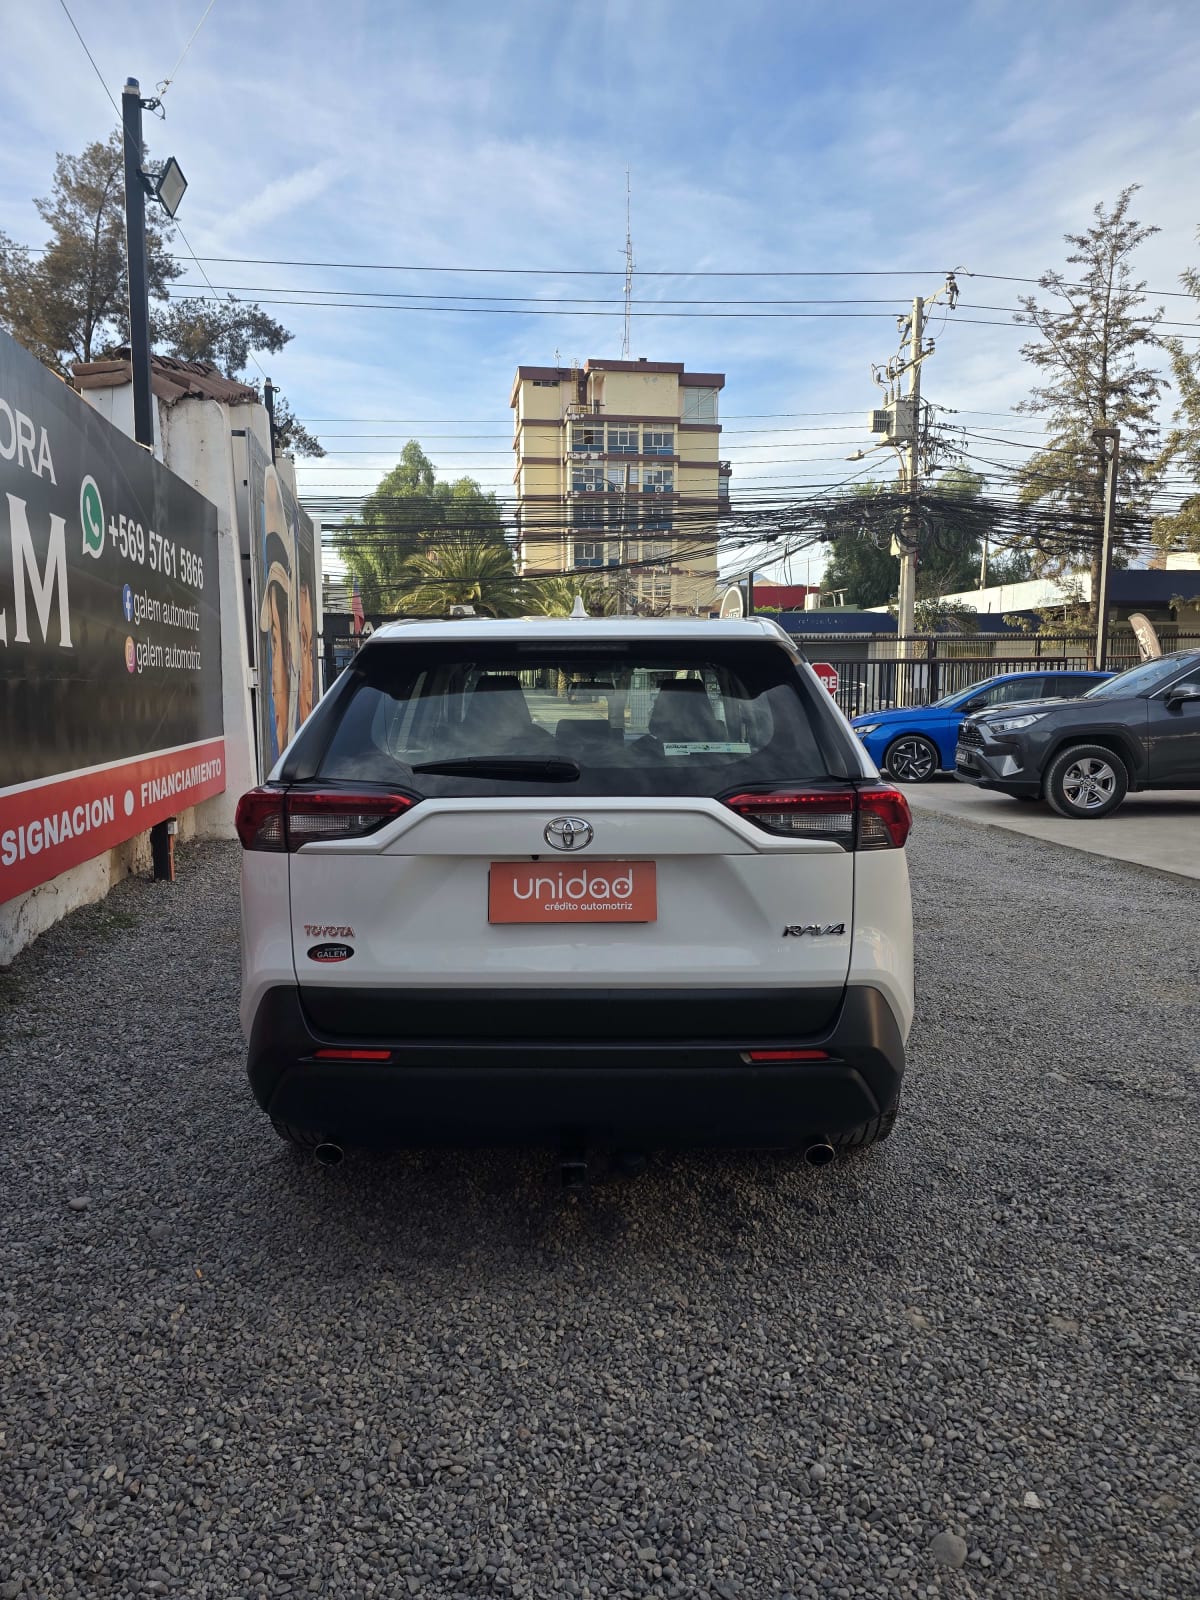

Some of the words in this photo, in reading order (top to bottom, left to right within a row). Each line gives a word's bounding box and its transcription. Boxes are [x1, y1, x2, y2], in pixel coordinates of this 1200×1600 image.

[109, 514, 145, 565] +569
[149, 530, 177, 579] 5761
[180, 547, 204, 590] 5866
[134, 589, 161, 625] galem
[162, 601, 200, 632] automotriz
[136, 637, 163, 674] galem
[165, 645, 202, 670] automotriz
[1, 795, 115, 866] SIGNACION
[140, 757, 222, 807] FINANCIAMIENTO
[513, 868, 633, 899] unidad
[544, 902, 578, 911] crédito
[580, 901, 633, 911] automotriz
[304, 924, 355, 937] TOYOTA
[782, 923, 846, 937] RAV4
[317, 950, 347, 958] GALEM
